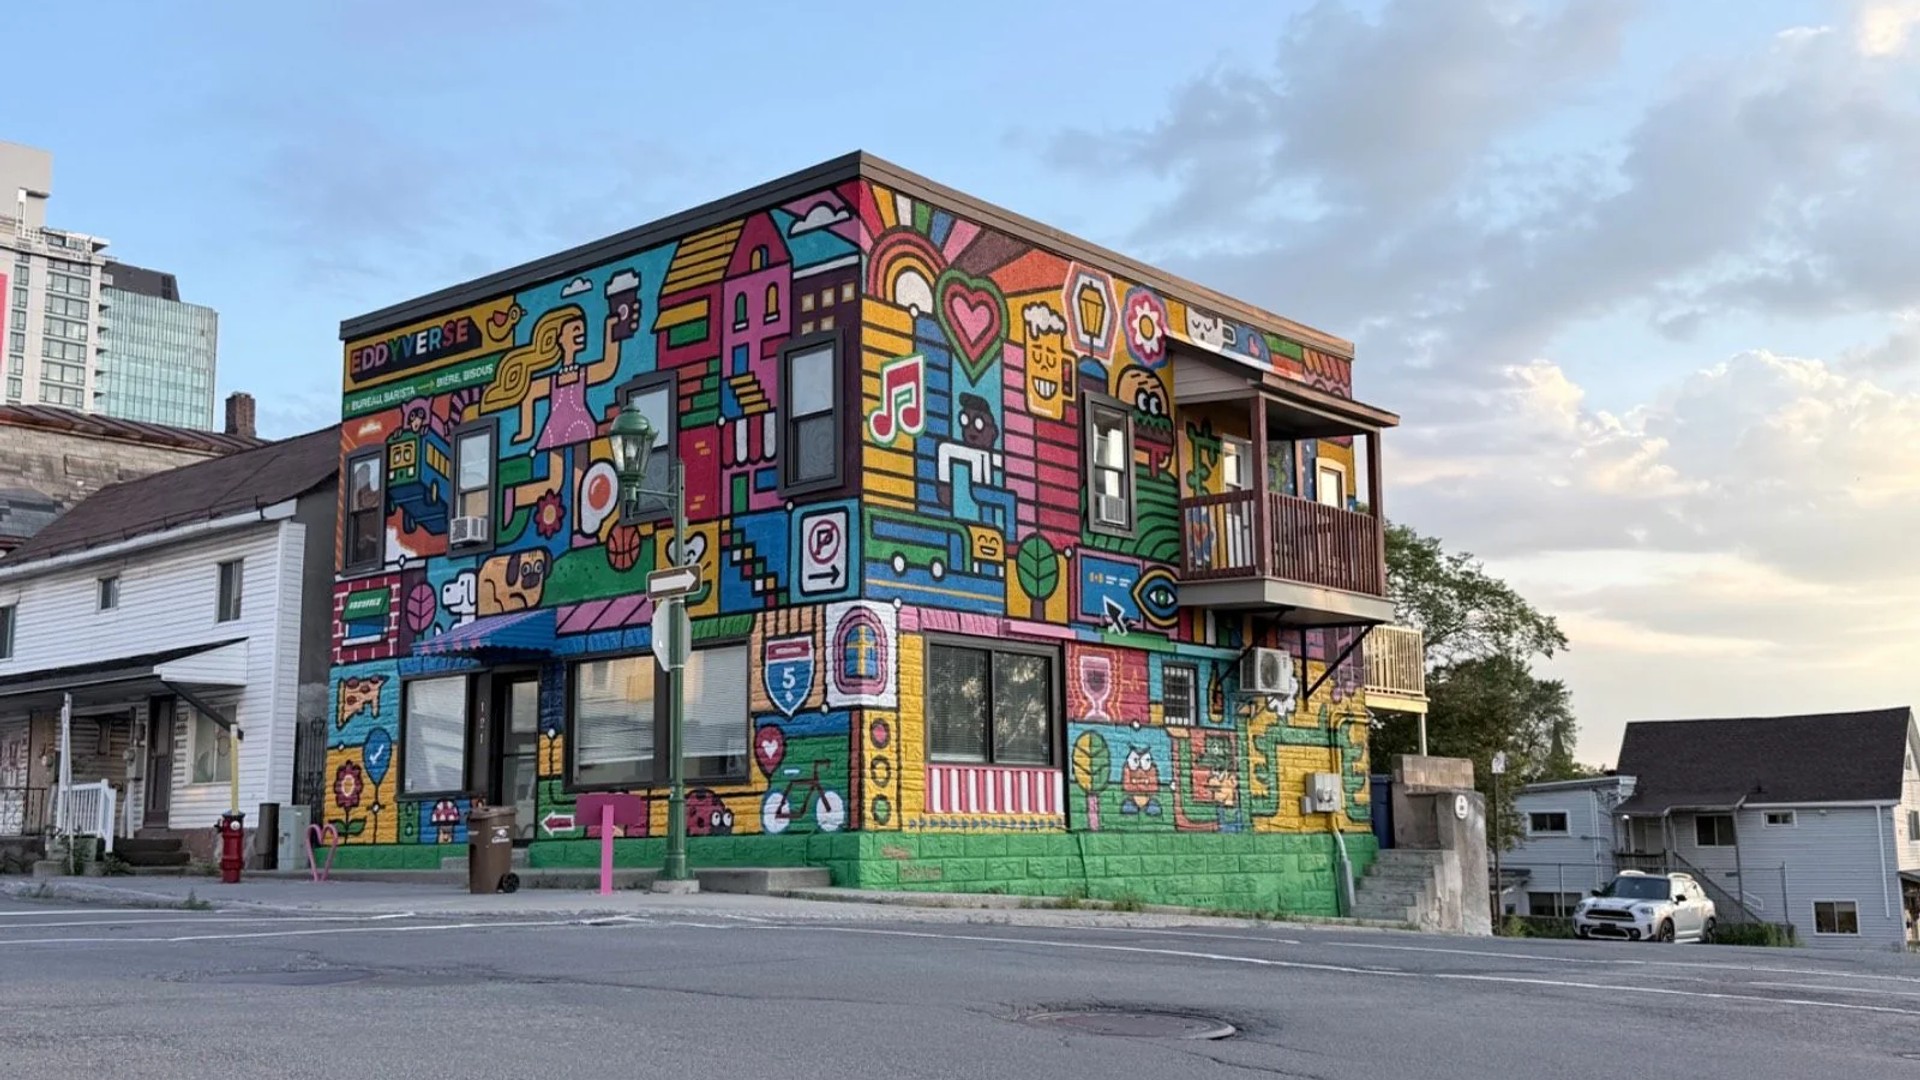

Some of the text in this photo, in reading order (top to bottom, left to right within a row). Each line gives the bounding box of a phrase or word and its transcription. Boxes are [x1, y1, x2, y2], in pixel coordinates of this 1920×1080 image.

[351, 318, 470, 374] EDDYVERSE
[384, 386, 415, 403] BARISTA
[463, 364, 494, 381] BISOUS
[816, 529, 834, 556] P
[782, 667, 796, 689] 5
